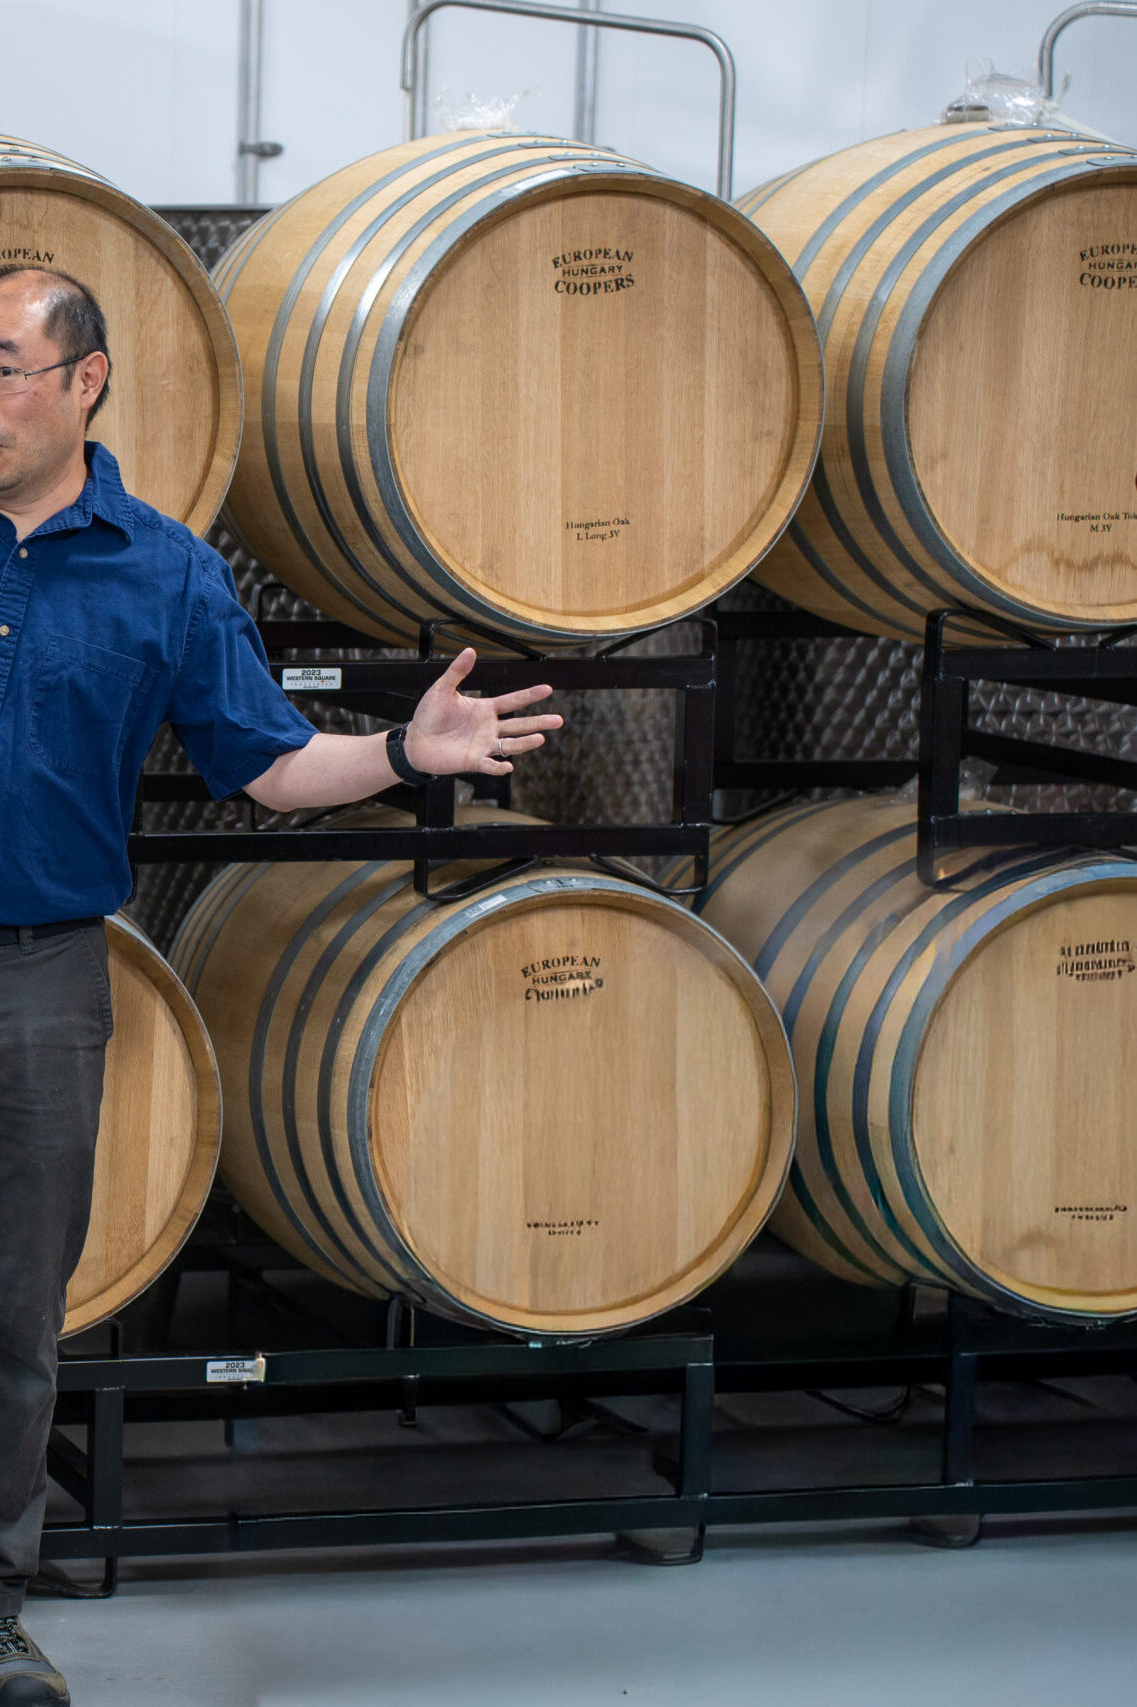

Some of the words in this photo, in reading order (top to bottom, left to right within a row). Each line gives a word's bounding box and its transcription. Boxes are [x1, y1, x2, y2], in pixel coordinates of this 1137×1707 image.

[552, 248, 634, 269] EUROPEAN
[562, 265, 624, 277] HUNGARY
[554, 273, 635, 296] COOPERS
[566, 519, 611, 531] Hungarian
[612, 516, 631, 526] Oak
[1057, 512, 1101, 522] Hungarian
[1103, 512, 1120, 521] Oak
[521, 955, 601, 978] EUROPEAN
[532, 970, 592, 986] HUNGARY
[225, 1361, 246, 1369] 2023
